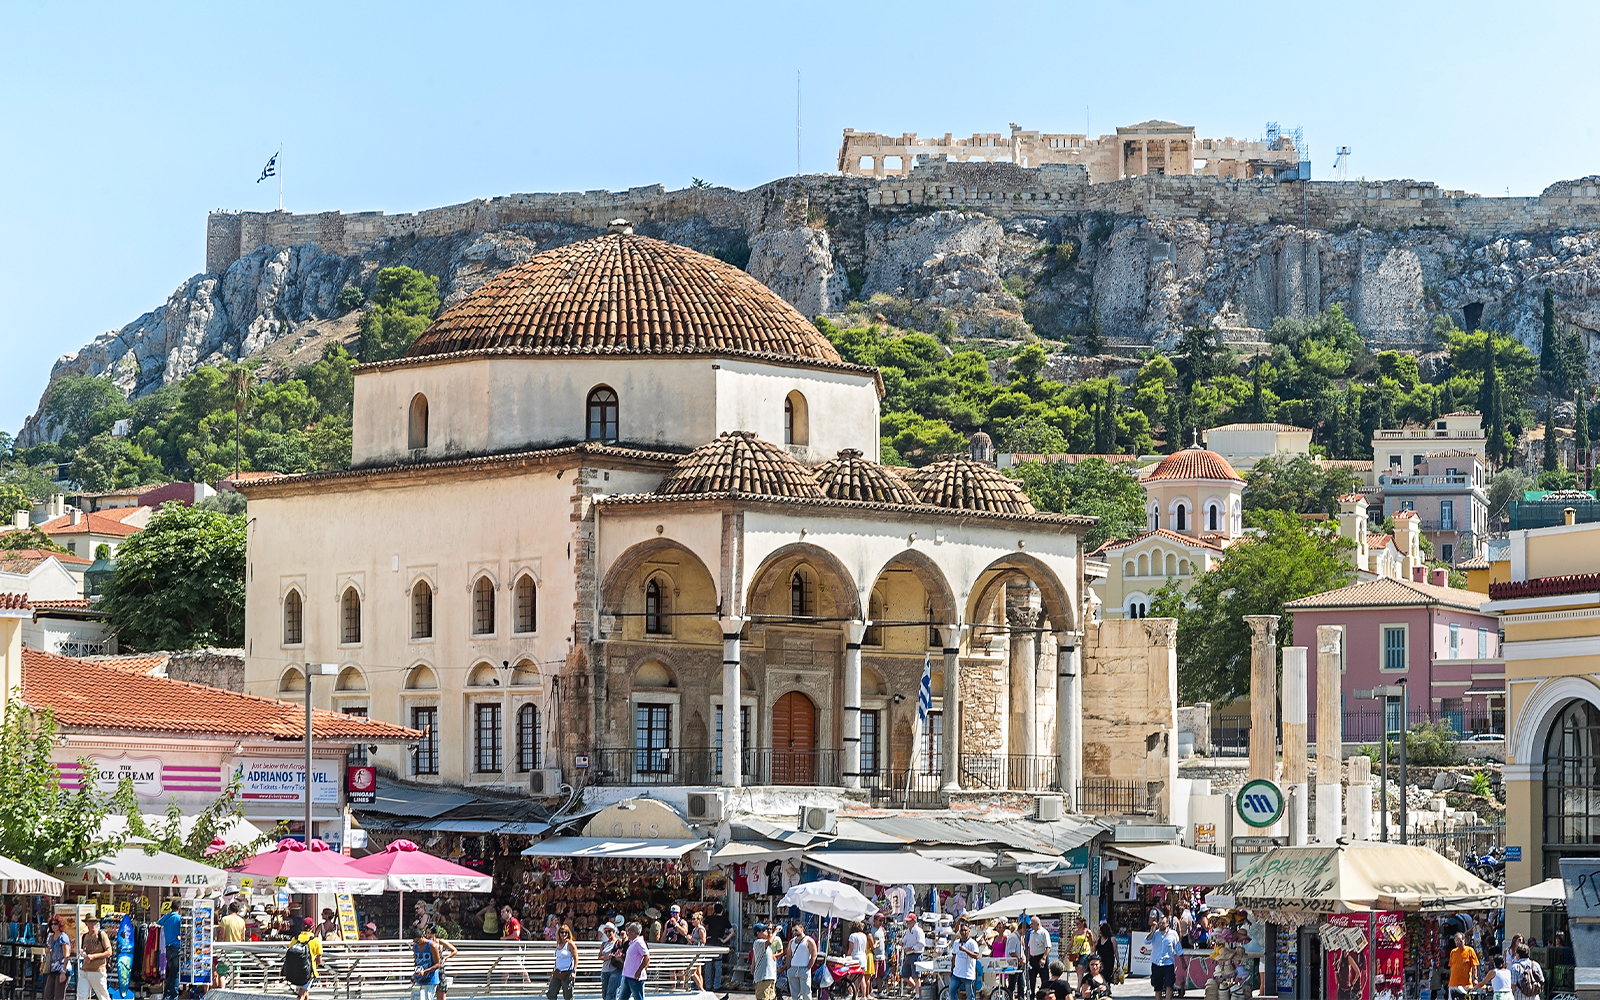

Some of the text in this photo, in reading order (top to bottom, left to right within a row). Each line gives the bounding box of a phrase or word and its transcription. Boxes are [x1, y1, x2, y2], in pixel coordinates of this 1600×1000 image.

[96, 770, 154, 781] ICE CREAM
[247, 771, 328, 783] ADRIANOS TRVEL
[282, 784, 295, 792] Ferry
[611, 821, 659, 838] GES
[118, 872, 142, 881] ΑΛΦΑ
[184, 874, 208, 885] ALFA
